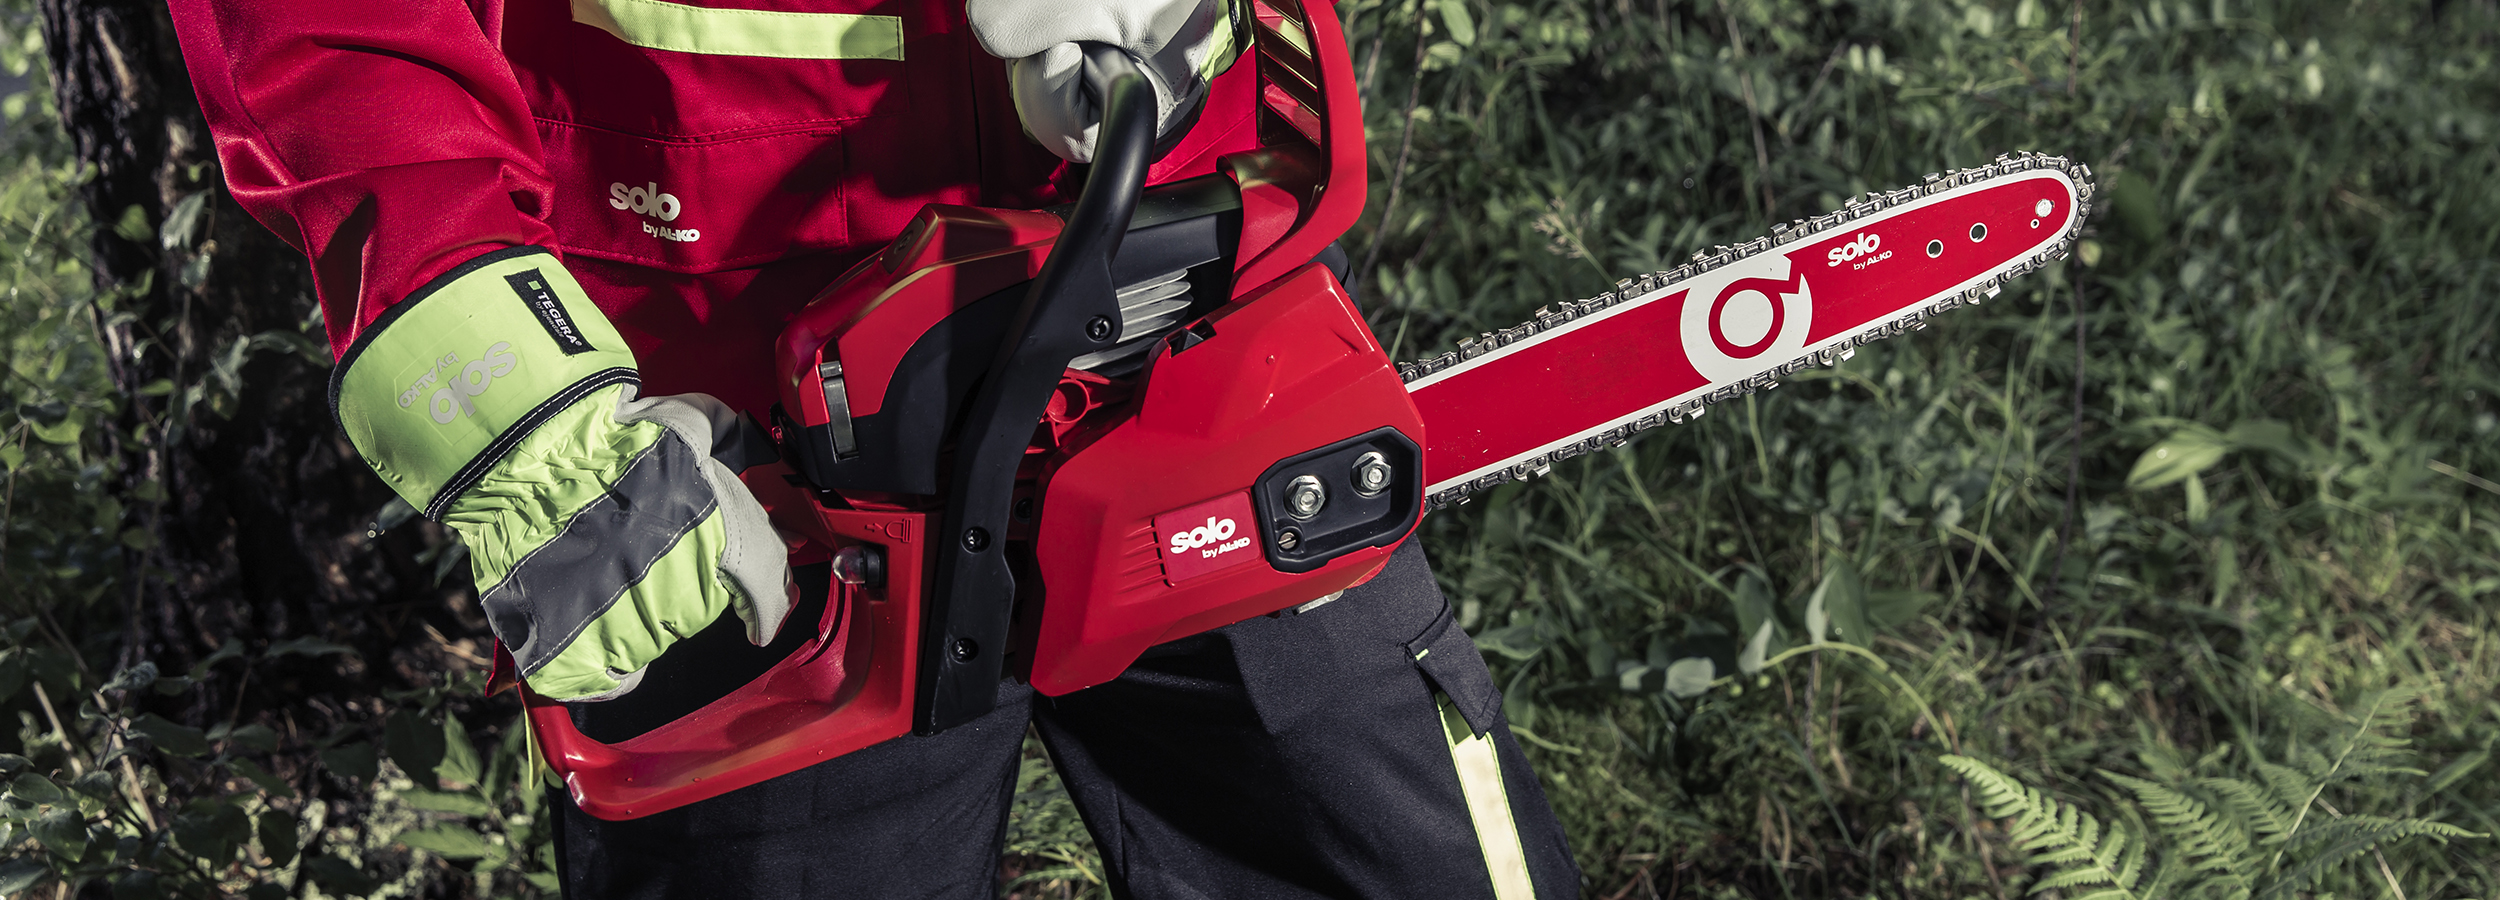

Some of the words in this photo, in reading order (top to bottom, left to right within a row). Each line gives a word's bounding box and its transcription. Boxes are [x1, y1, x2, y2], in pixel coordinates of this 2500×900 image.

[609, 181, 681, 222] solo
[643, 221, 658, 238] by
[660, 226, 700, 242] AL-KO
[1827, 232, 1880, 267] solo
[1853, 261, 1866, 270] by
[1866, 250, 1893, 266] AL-KO
[535, 301, 544, 310] by
[435, 351, 460, 373] by
[398, 366, 438, 408] AL-KO
[429, 341, 517, 425] solo
[1170, 516, 1236, 554] solo
[1202, 548, 1218, 559] by
[1218, 537, 1250, 554] AL-KO
